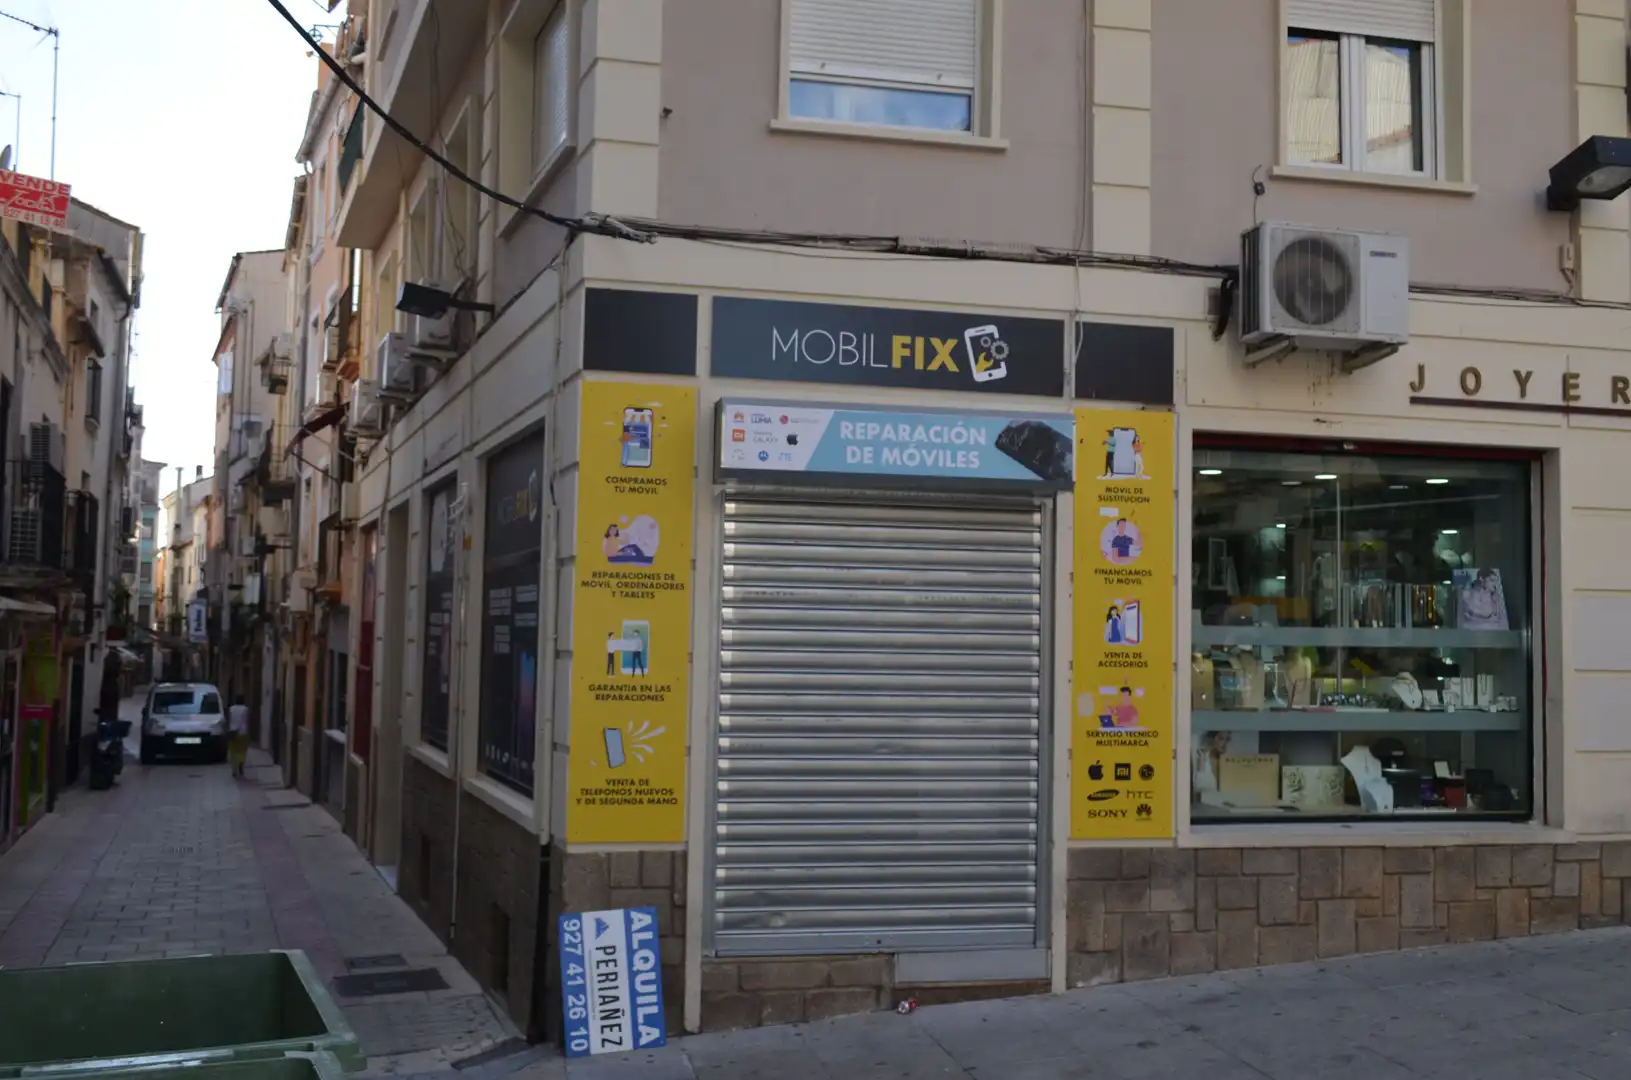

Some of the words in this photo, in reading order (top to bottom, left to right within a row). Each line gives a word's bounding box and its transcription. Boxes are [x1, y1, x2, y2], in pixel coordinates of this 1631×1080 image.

[840, 420, 986, 446] REPARACIÓN
[846, 446, 873, 464] DE
[881, 444, 980, 469] MÓVILES
[605, 476, 667, 486] COMPRAMOS
[592, 571, 661, 581] REPARACIONES
[664, 573, 675, 581] DE
[1094, 568, 1152, 577] FINANCIAMOS
[616, 581, 685, 590] ORDENADORES
[620, 591, 655, 599] TABLETS
[1098, 660, 1148, 668] ACCESORIOS
[640, 684, 652, 692] EN
[655, 685, 671, 693] LAS
[595, 693, 665, 702] REPARACIONES
[1086, 730, 1123, 738] SERVICIO
[1096, 739, 1149, 747] MULTIMARCA
[605, 778, 636, 786] VENTA
[635, 788, 674, 796] NUEVOS
[1088, 809, 1128, 818] SONY
[563, 918, 583, 956] 927
[566, 962, 584, 986] 41
[630, 911, 661, 1046] ALQUILA
[595, 945, 625, 1048] PERIAÑEZ
[568, 994, 586, 1020] 26
[570, 1026, 588, 1051] 10
